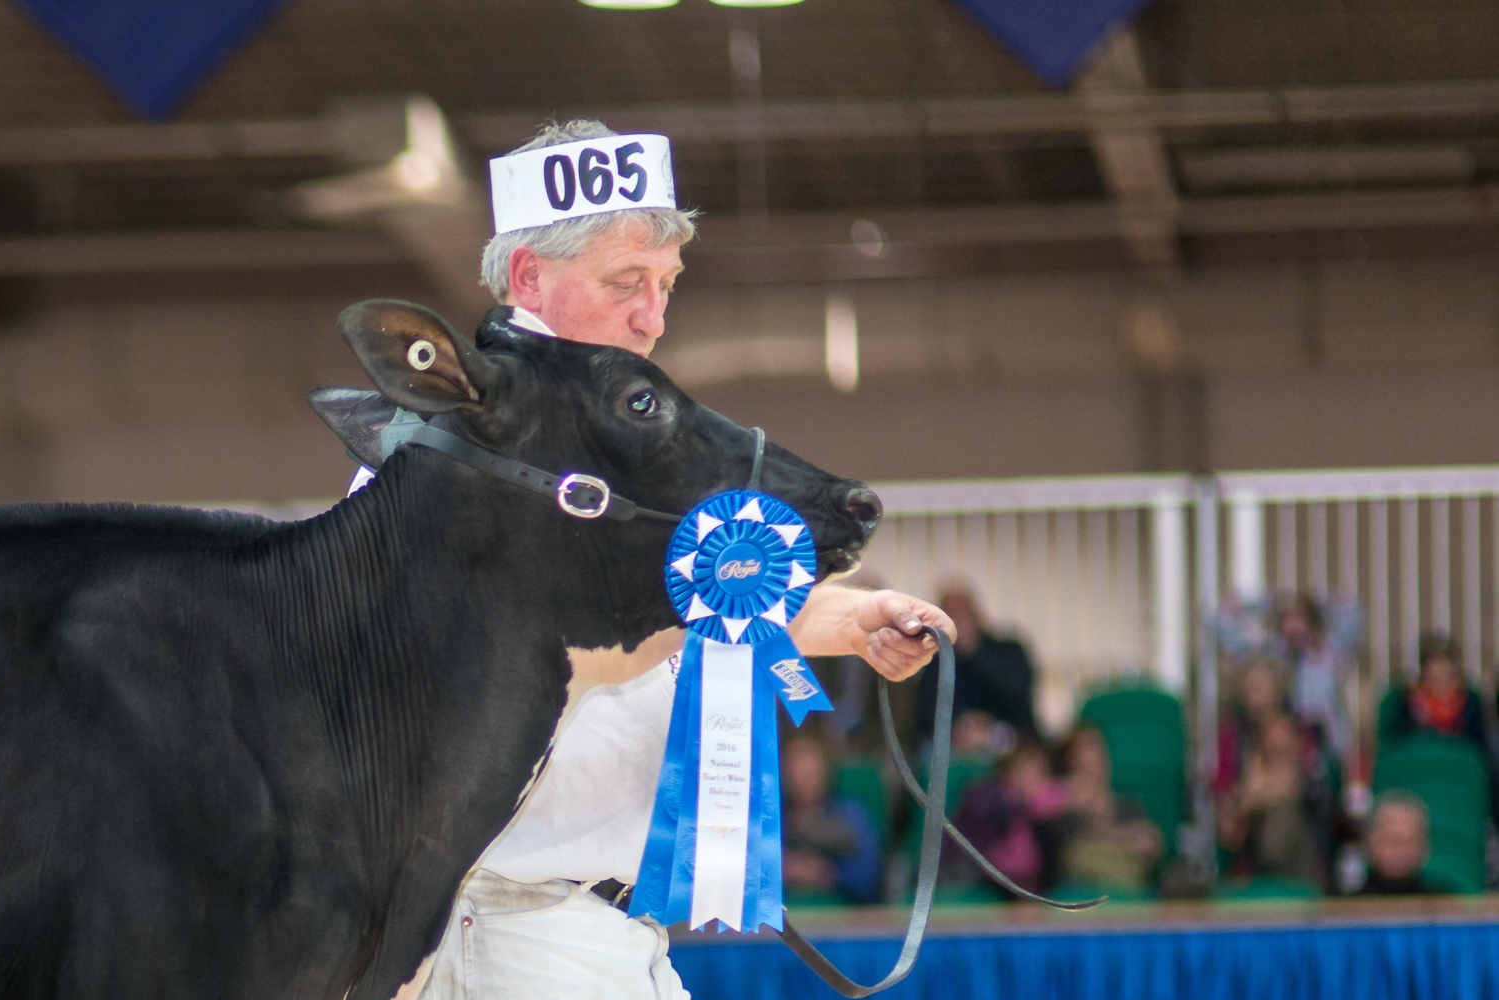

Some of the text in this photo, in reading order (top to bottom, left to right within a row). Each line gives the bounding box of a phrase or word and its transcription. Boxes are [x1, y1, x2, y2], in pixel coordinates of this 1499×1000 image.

[544, 142, 647, 211] 065
[719, 560, 762, 580] Royal
[777, 666, 810, 693] SECOND
[705, 714, 745, 732] Royal
[716, 742, 737, 752] 2016
[711, 759, 741, 768] National
[703, 772, 720, 781] Black
[728, 773, 746, 783] White
[709, 787, 739, 796] Holstein
